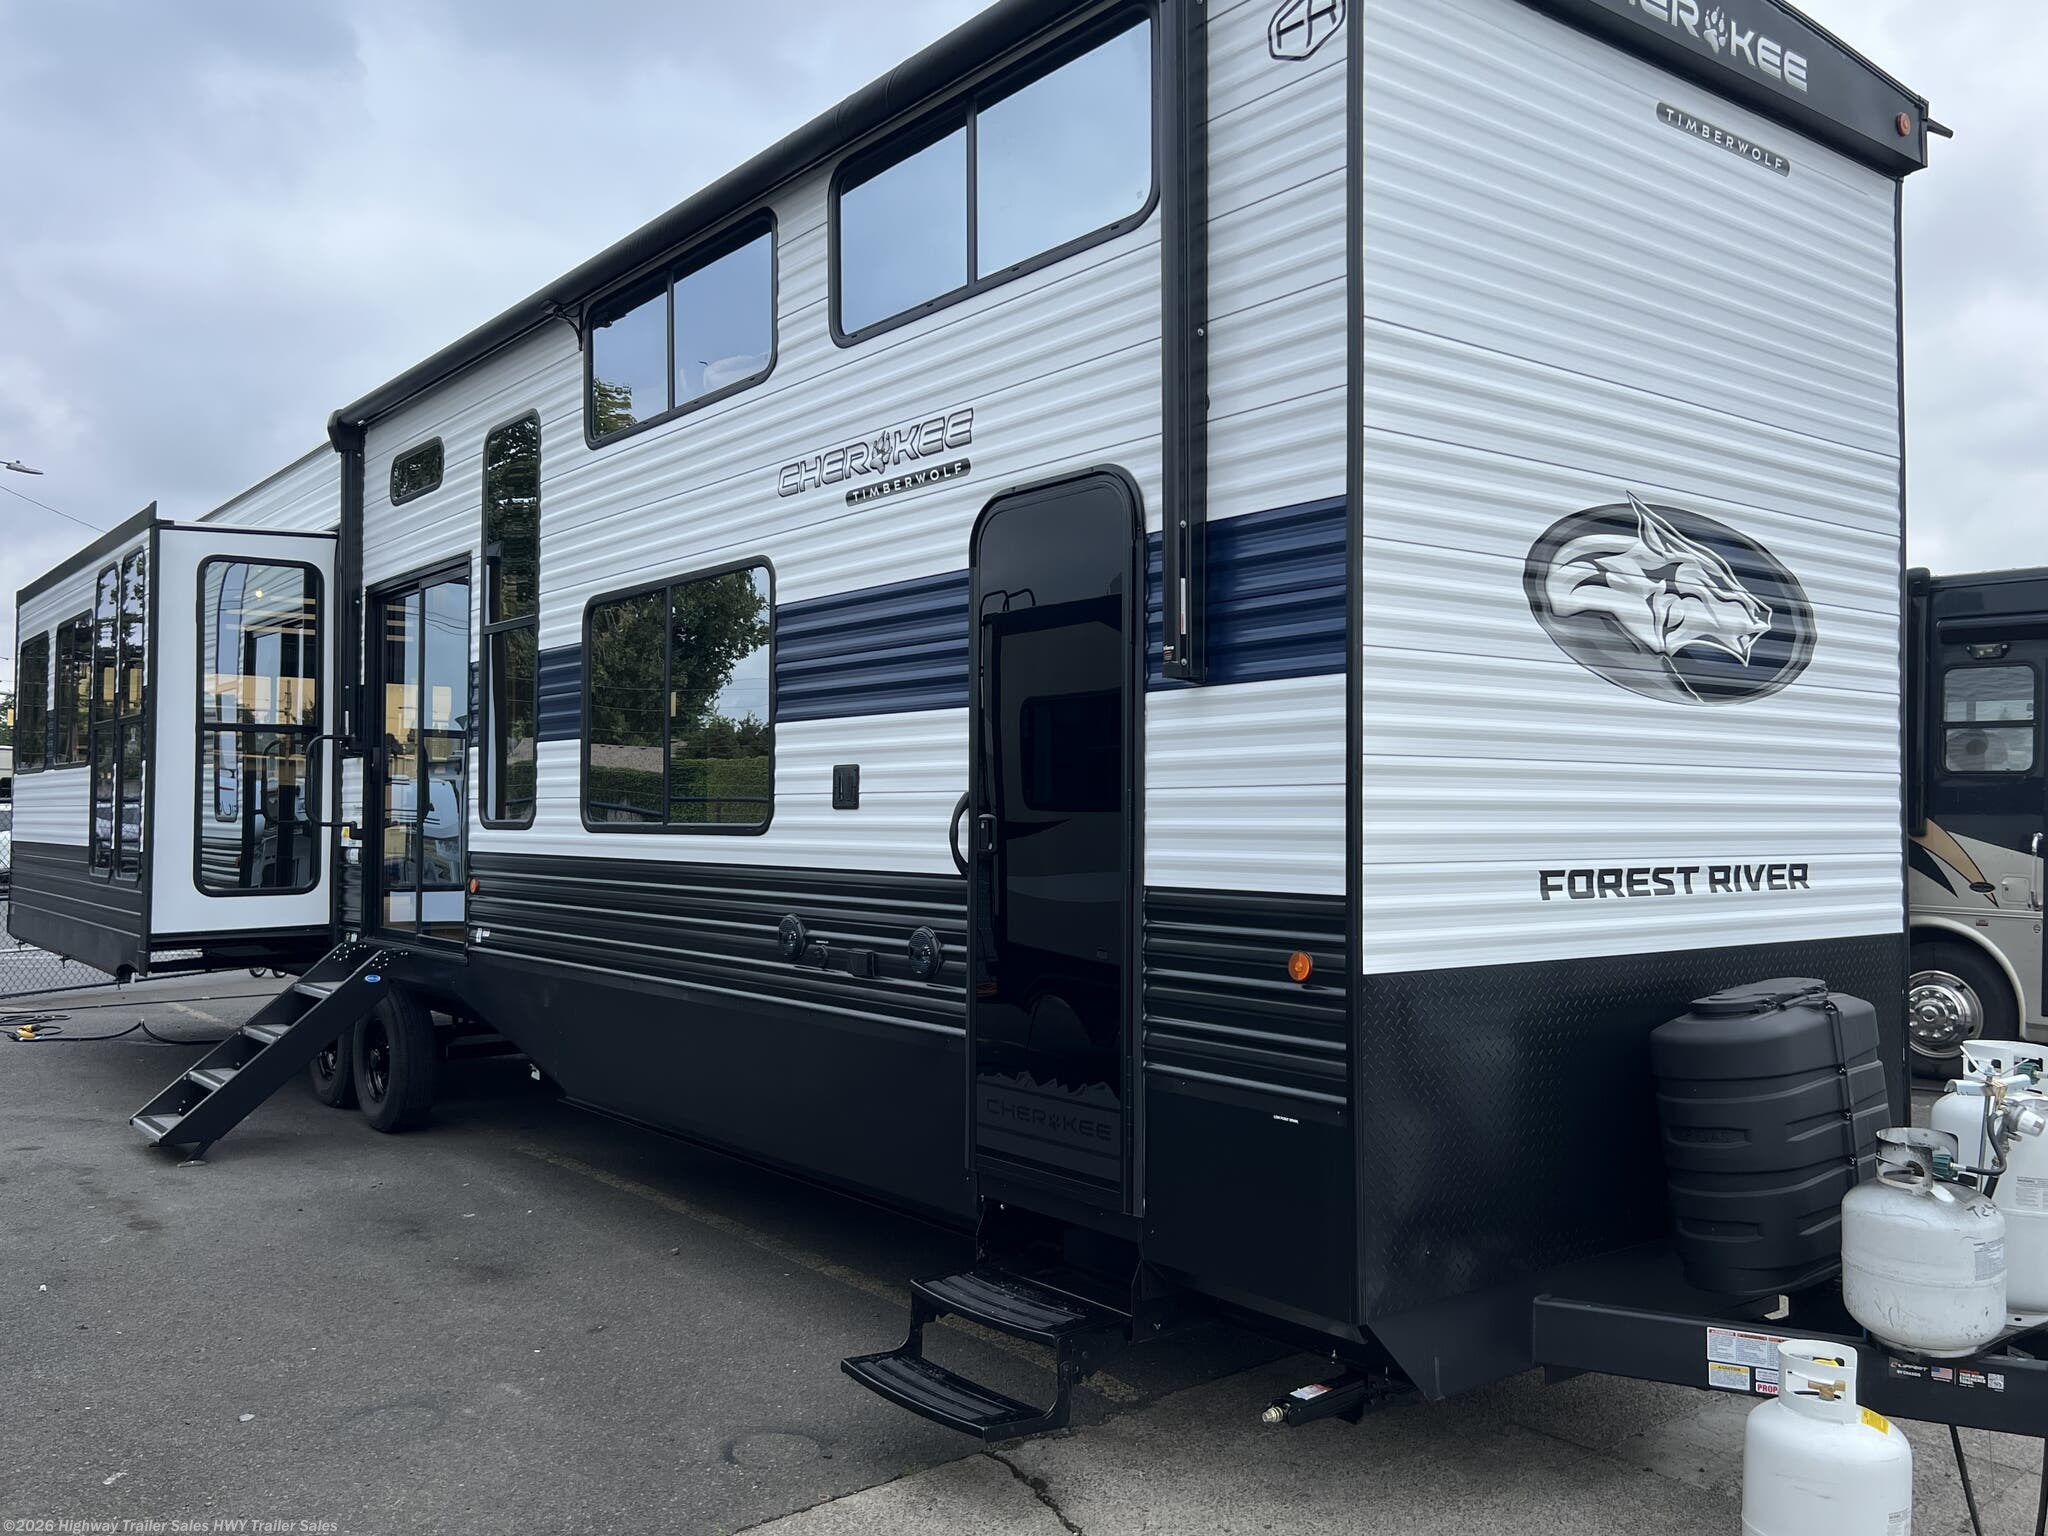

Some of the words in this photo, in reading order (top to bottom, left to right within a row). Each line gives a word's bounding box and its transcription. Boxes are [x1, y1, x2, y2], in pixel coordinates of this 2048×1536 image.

[1665, 108, 1783, 170] TIMBERWOLF
[777, 407, 974, 498] CHEROKEE
[852, 462, 963, 502] TIMBERWOLF
[1538, 866, 1700, 900] FOREST
[1708, 863, 1810, 894] RIVER
